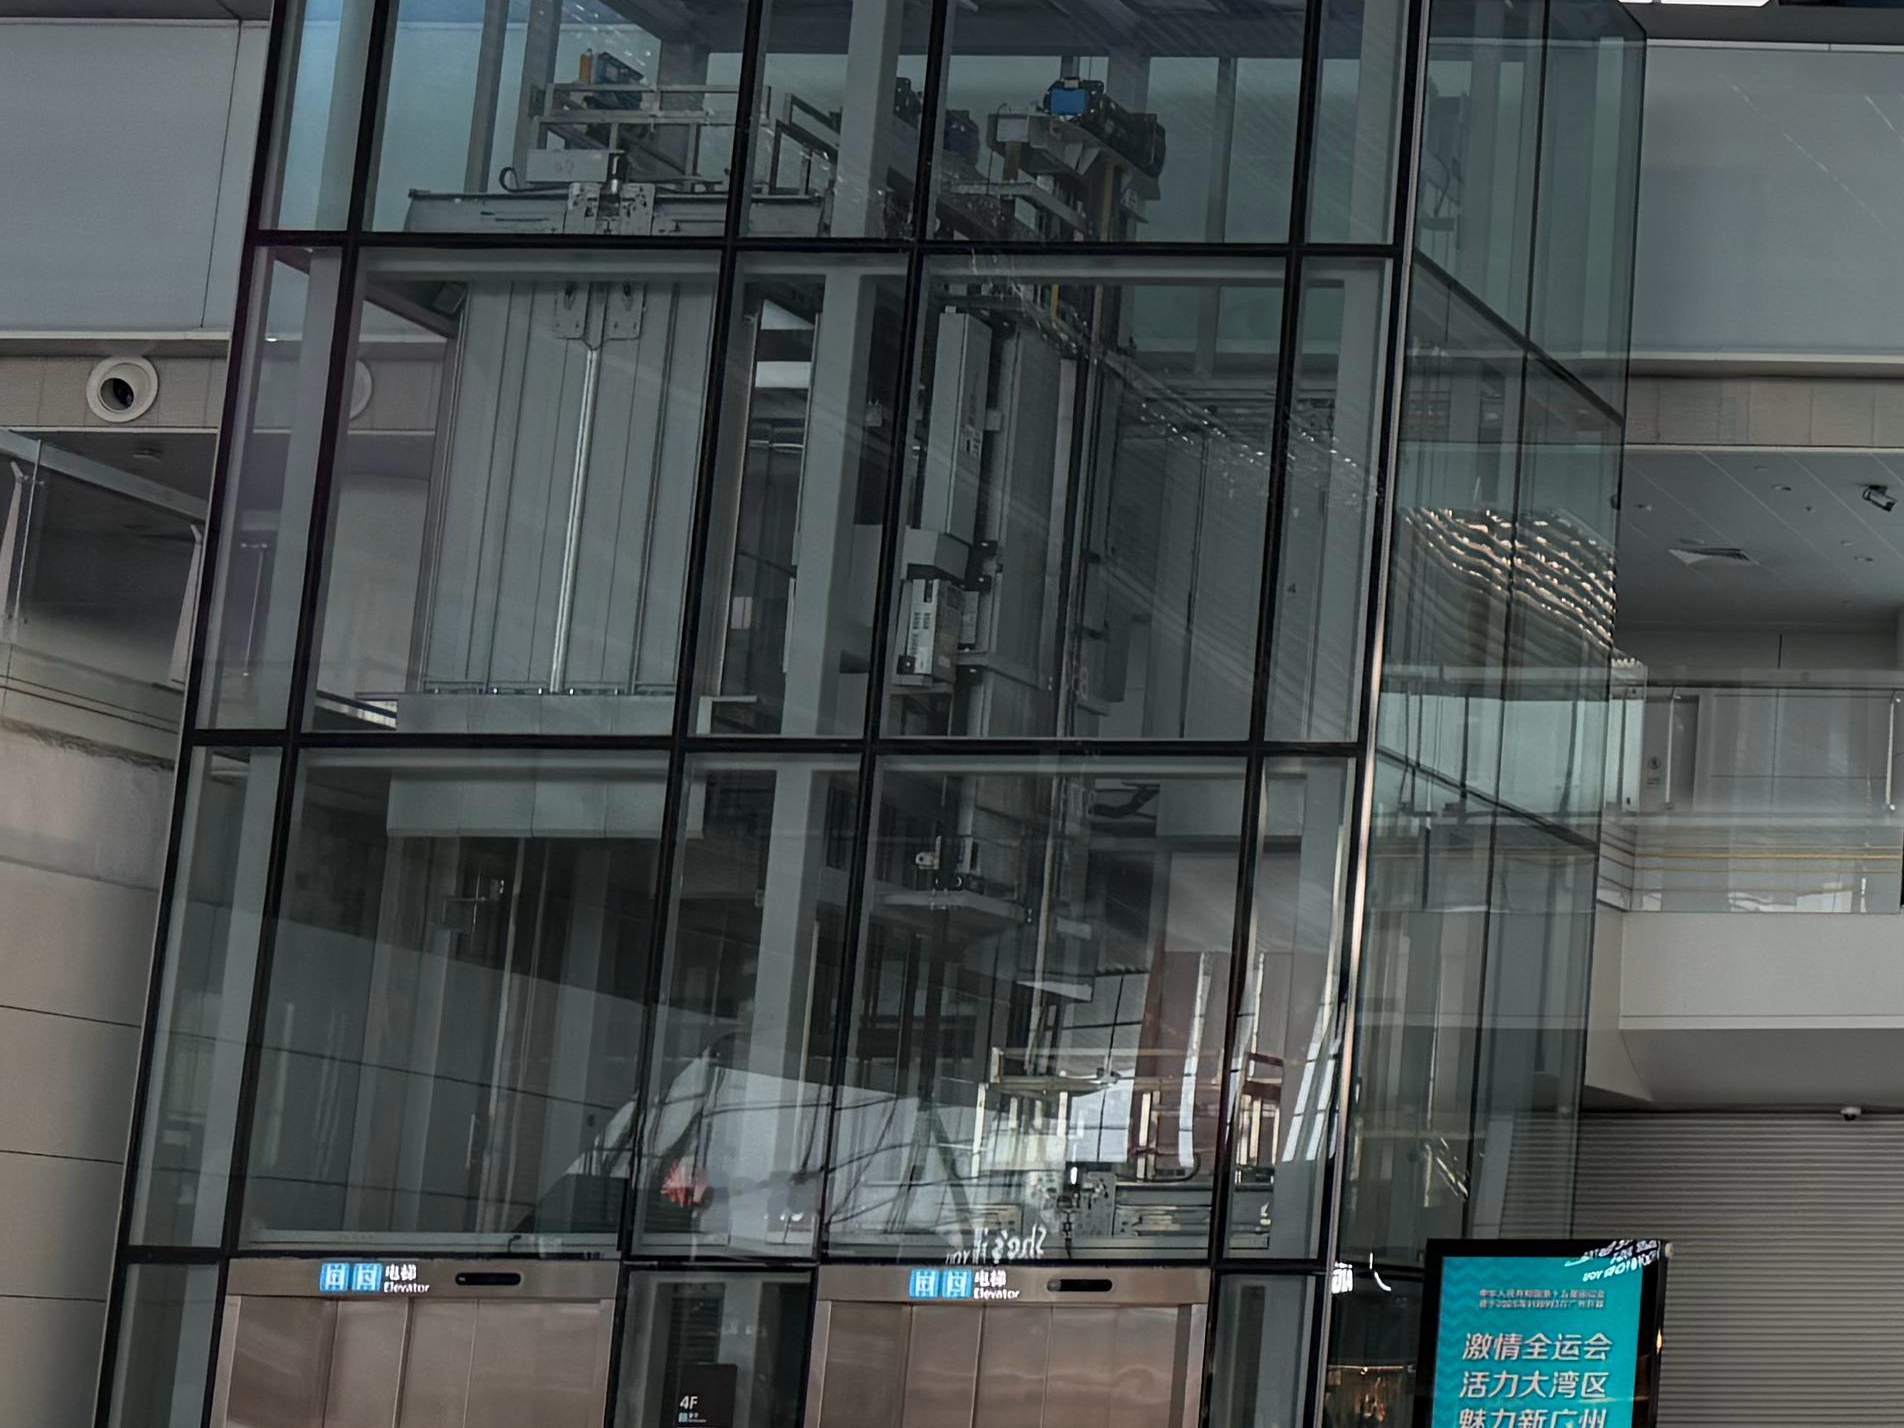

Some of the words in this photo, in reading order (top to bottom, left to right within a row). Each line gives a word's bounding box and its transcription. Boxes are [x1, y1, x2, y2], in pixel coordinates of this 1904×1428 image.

[385, 1263, 418, 1281] 电梯
[974, 1269, 1007, 1287] 电梯
[383, 1280, 430, 1293] Elevator
[973, 1287, 1020, 1300] Elevator
[1462, 1331, 1613, 1363] 激情全运会
[1459, 1370, 1611, 1401] 活力大湾区
[680, 1395, 698, 1410] 4F
